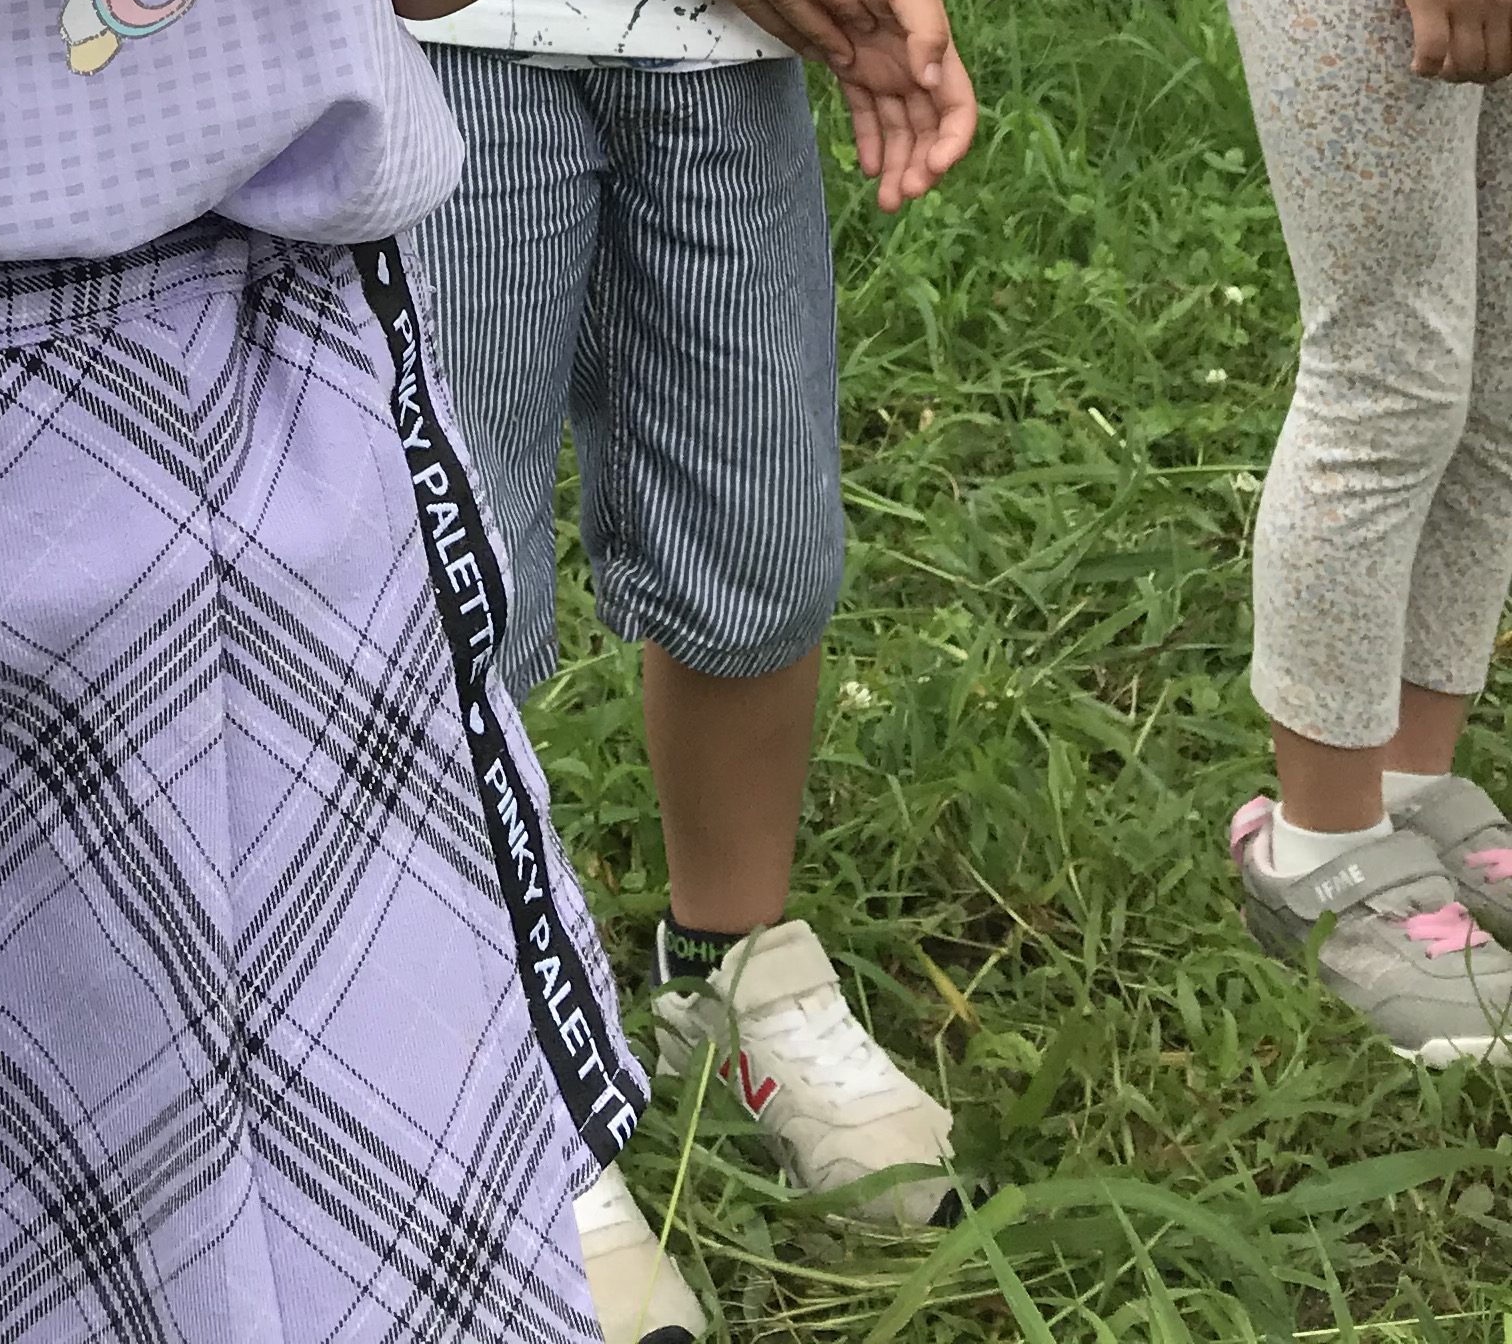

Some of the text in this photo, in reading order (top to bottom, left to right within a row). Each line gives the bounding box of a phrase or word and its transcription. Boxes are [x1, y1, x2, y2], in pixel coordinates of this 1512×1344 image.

[393, 309, 494, 685] PINKY PALETTE
[484, 758, 638, 1150] PINKY PALETTE
